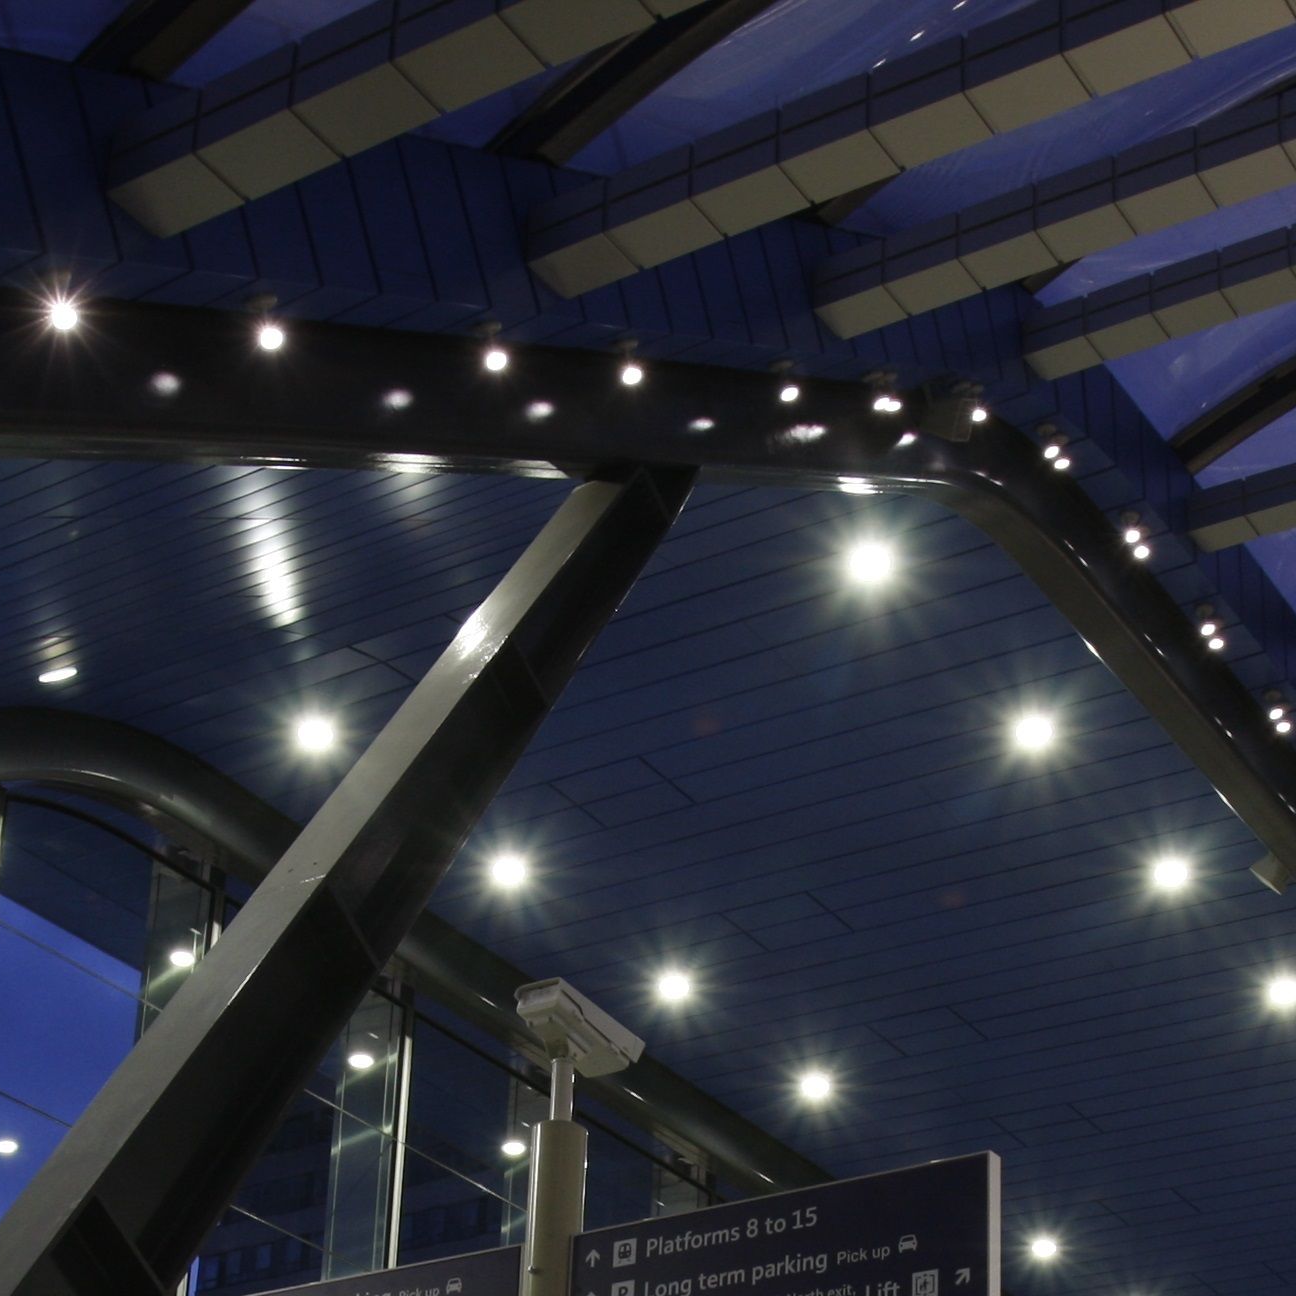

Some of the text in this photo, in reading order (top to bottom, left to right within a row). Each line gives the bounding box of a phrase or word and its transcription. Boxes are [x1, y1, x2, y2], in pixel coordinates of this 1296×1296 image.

[646, 1206, 818, 1257] Platforms 8 to 15
[698, 1268, 745, 1290] term
[752, 1253, 828, 1285] parking
[837, 1248, 868, 1265] Pick
[872, 1246, 891, 1260] up
